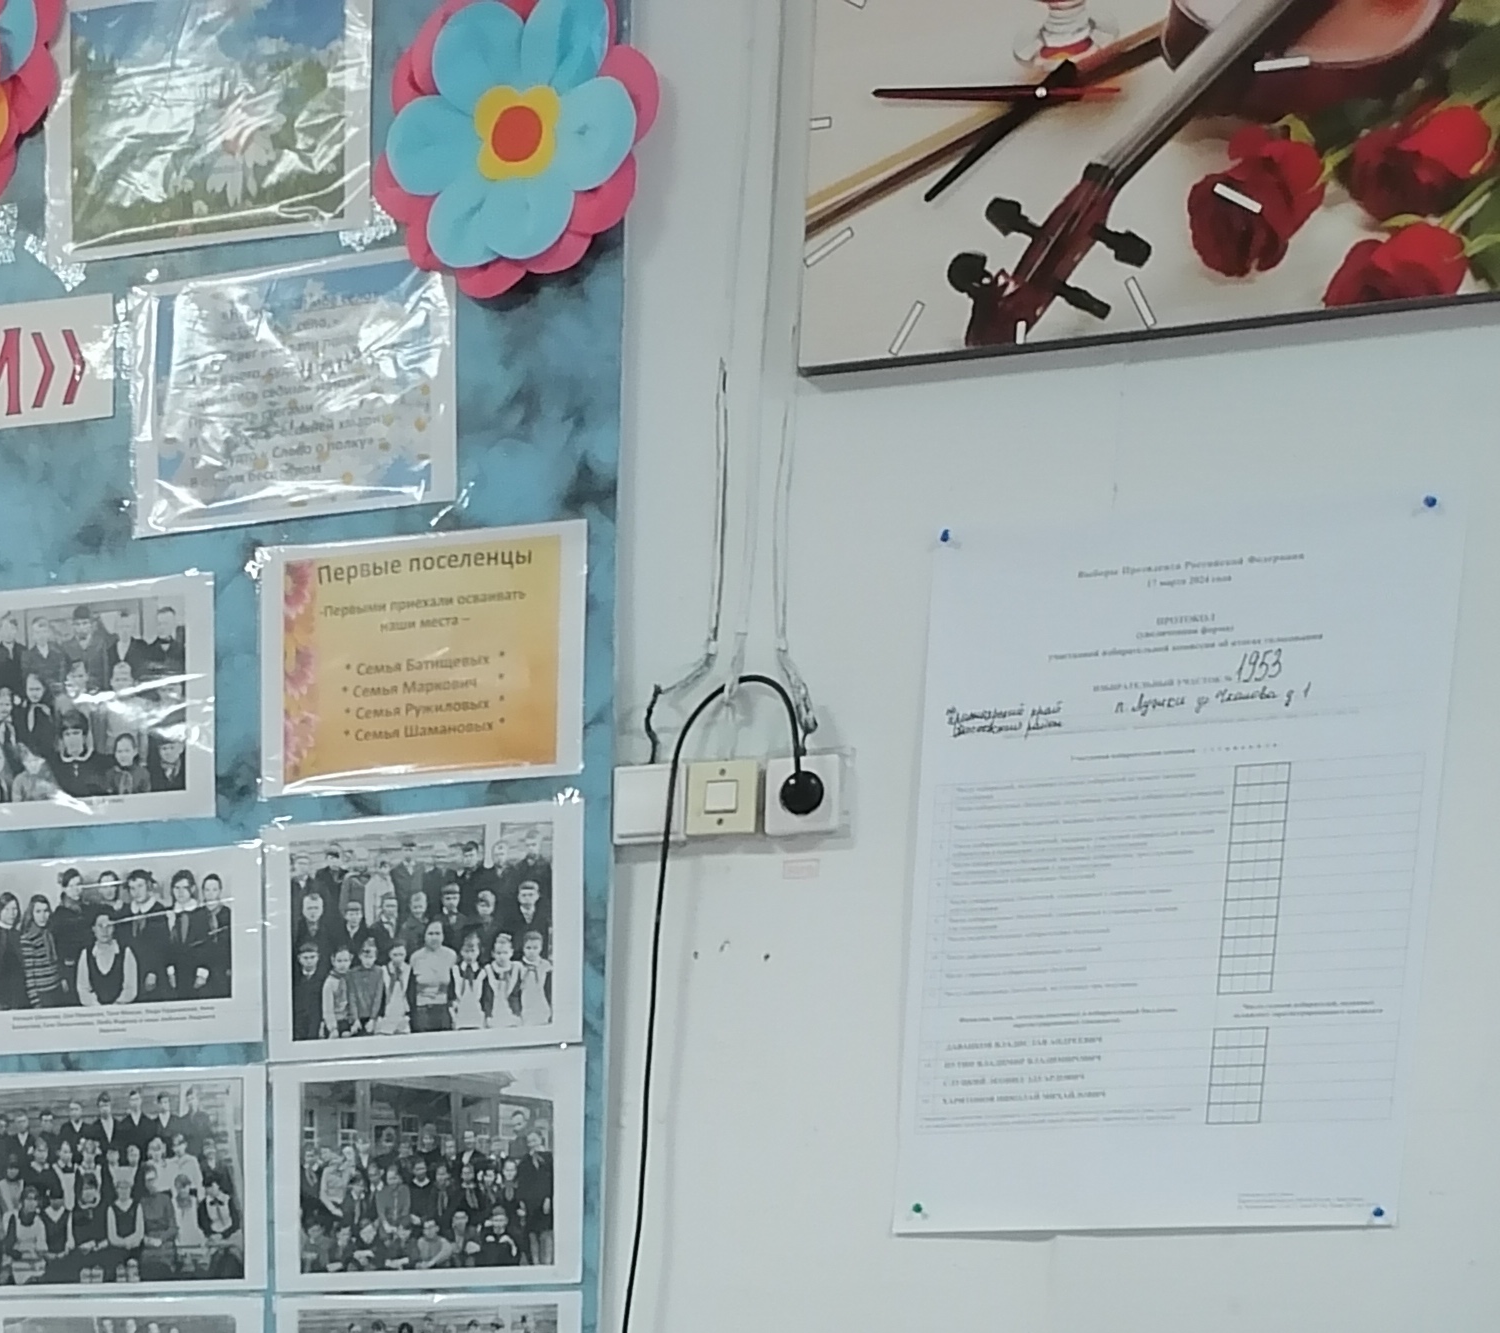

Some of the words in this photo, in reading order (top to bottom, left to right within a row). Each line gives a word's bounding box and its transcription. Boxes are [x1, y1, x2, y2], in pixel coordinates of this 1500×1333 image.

[317, 558, 401, 586] Первые
[409, 548, 533, 574] поселенцы
[390, 594, 454, 616] приехали
[379, 620, 417, 633] наши
[420, 615, 459, 630] места
[356, 661, 402, 676] Семья
[406, 654, 490, 673] Батищевых
[1235, 647, 1283, 683] 1953
[352, 683, 399, 698] Семья
[402, 677, 478, 696] Маркович
[355, 705, 401, 720] Семья
[404, 698, 490, 718] Ружиловых
[354, 726, 400, 742] Семья
[403, 721, 494, 738] Шамановых
